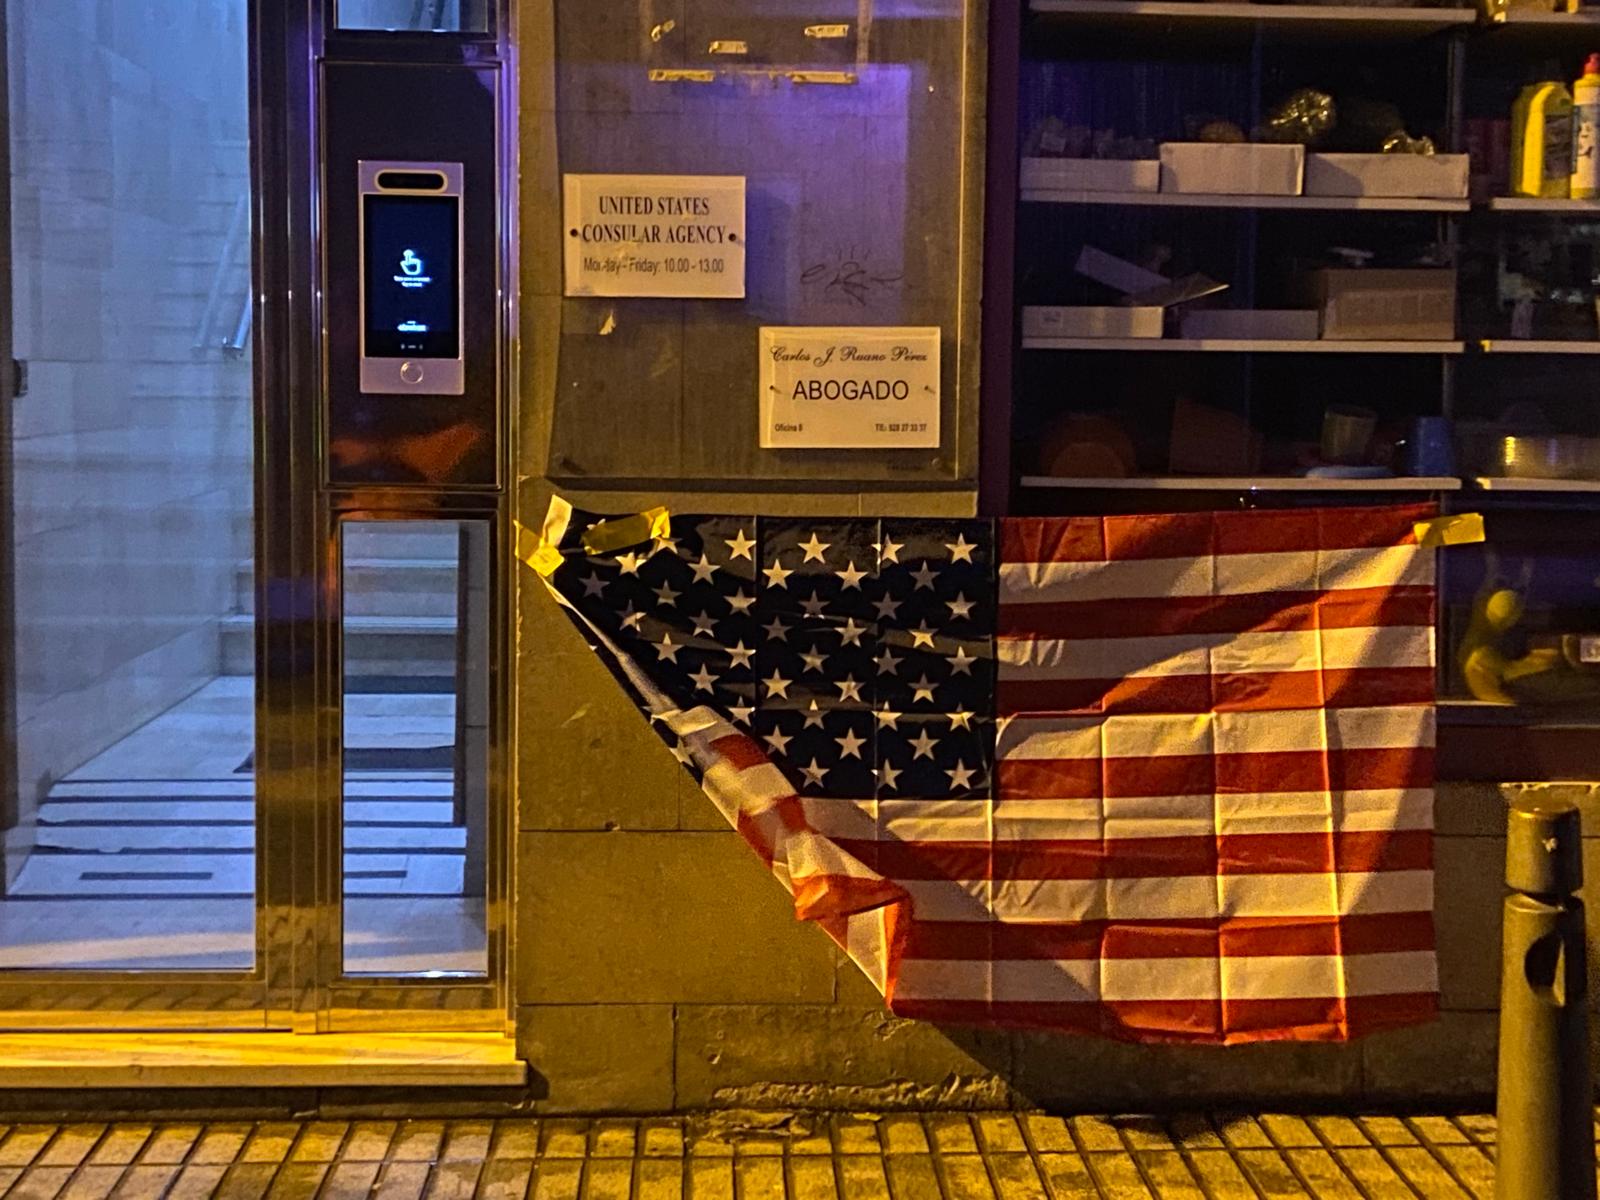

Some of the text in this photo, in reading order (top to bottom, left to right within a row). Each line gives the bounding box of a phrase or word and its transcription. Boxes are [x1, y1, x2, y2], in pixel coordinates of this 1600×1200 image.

[600, 196, 710, 216] UNITED STATES
[582, 224, 726, 244] CONSULAR AGENCY
[665, 257, 690, 273] 10.00
[699, 258, 724, 273] 13.00
[770, 345, 810, 362] Carlos
[840, 346, 886, 361] Ruano
[792, 380, 909, 400] ABOGADO
